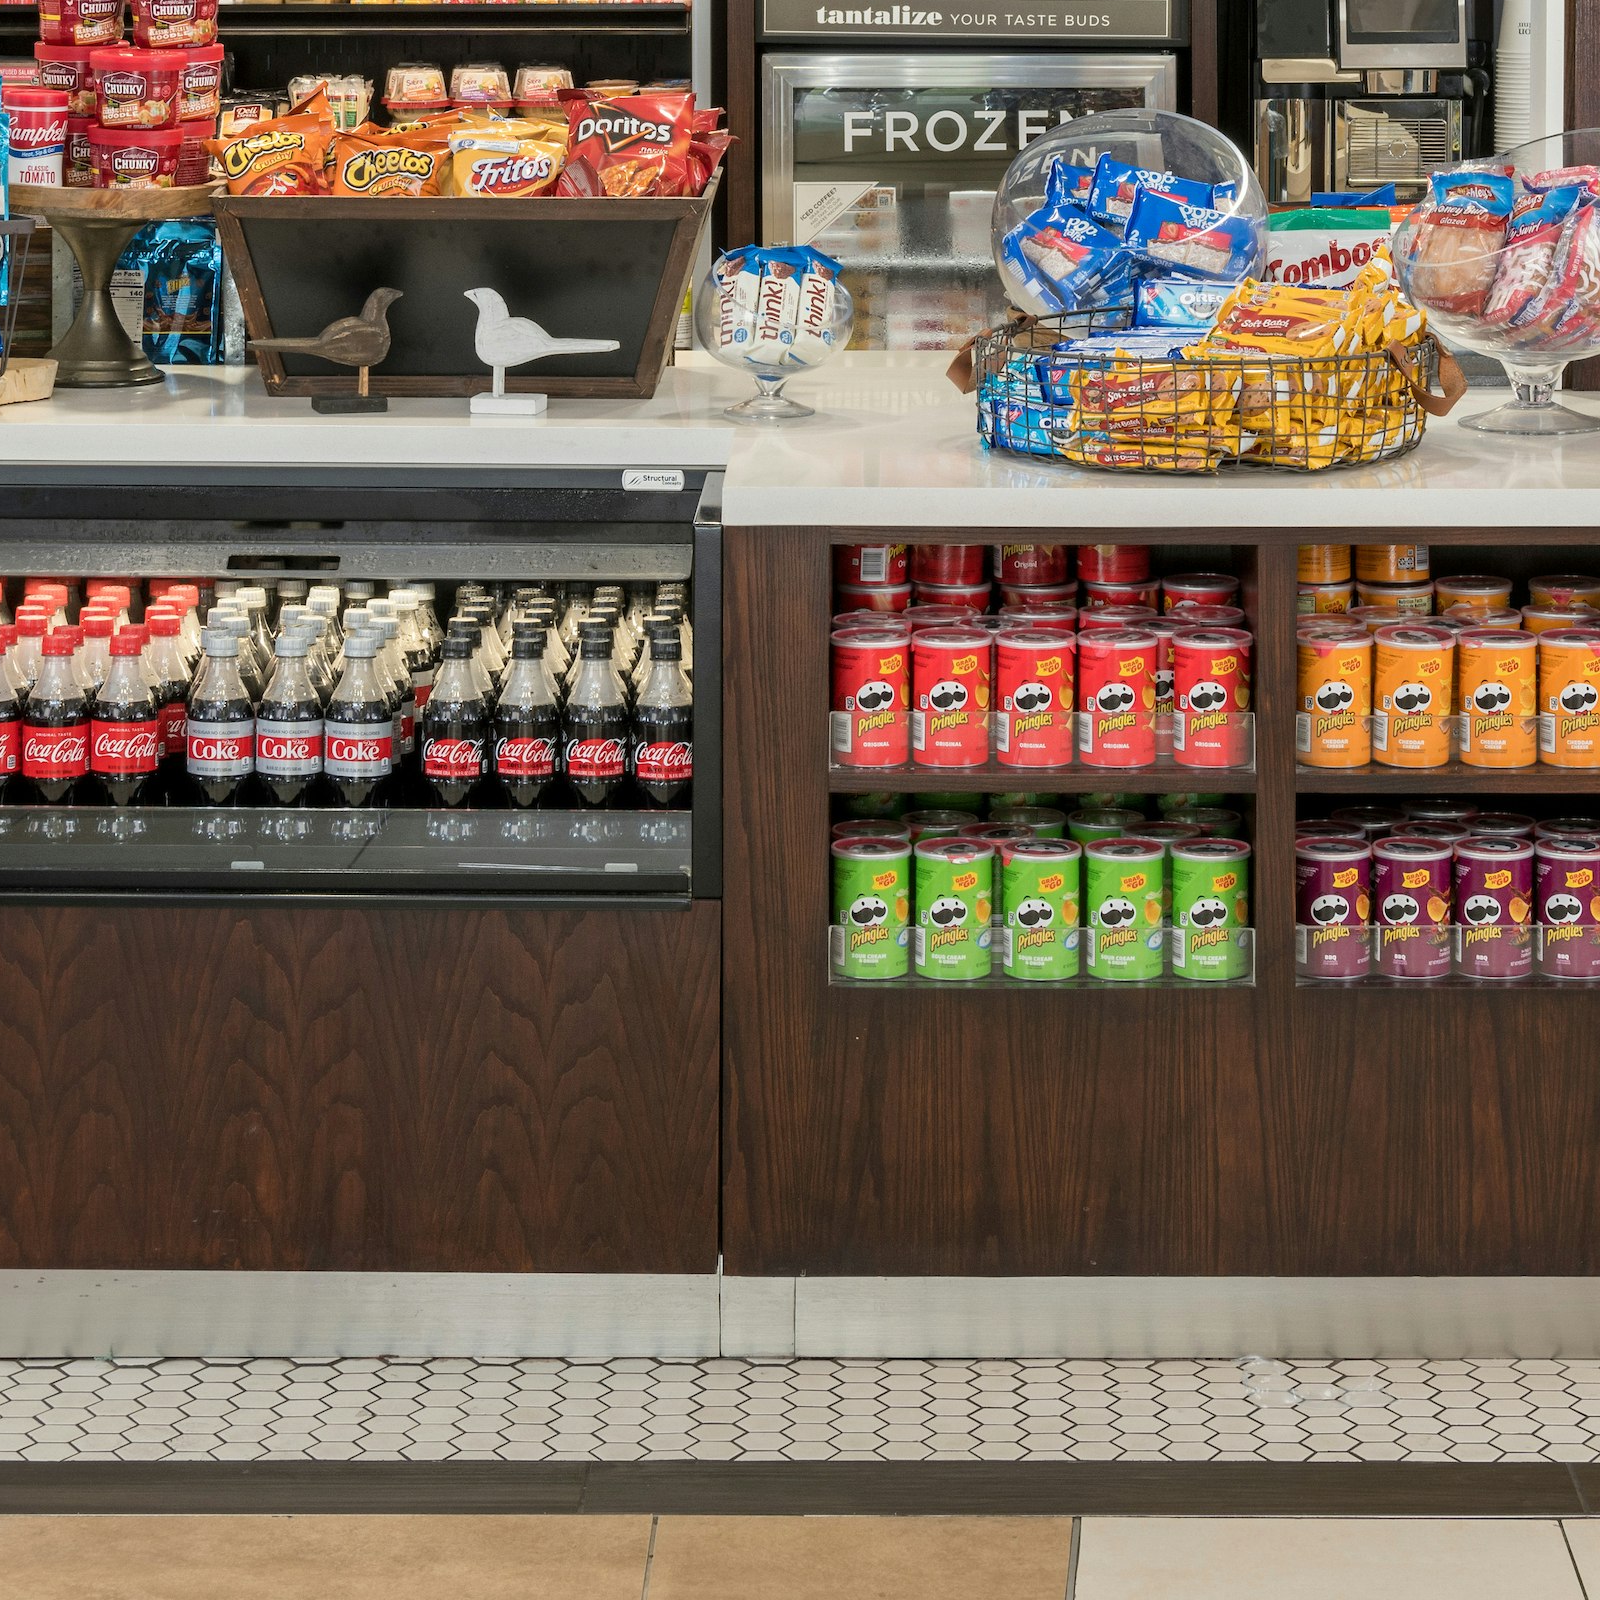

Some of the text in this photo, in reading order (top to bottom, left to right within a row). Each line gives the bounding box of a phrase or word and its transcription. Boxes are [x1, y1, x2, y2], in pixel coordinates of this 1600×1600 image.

[153, 4, 194, 16] CHUNKY
[816, 5, 1110, 27] tantalize YOUR TASTE BUDS
[104, 83, 143, 96] CHUNKY
[577, 118, 671, 144] Doritos
[224, 132, 305, 177] Cheetos
[253, 151, 294, 173] Crunchy
[19, 171, 56, 184] TOMATO
[344, 148, 432, 192] Cheetos
[471, 156, 552, 191] Fritos
[1439, 216, 1467, 226] Glazed
[1180, 292, 1225, 305] OREO
[857, 711, 895, 737] Pringles
[1097, 712, 1136, 738] Pringles
[24, 737, 84, 763] Coca-Cola
[95, 732, 156, 759] Coca-Cola
[192, 739, 240, 760] Coke
[262, 738, 309, 760] Coke
[424, 737, 485, 764] Coca-Cola
[1016, 928, 1056, 953] Pringles
[1464, 925, 1503, 948] Pringles
